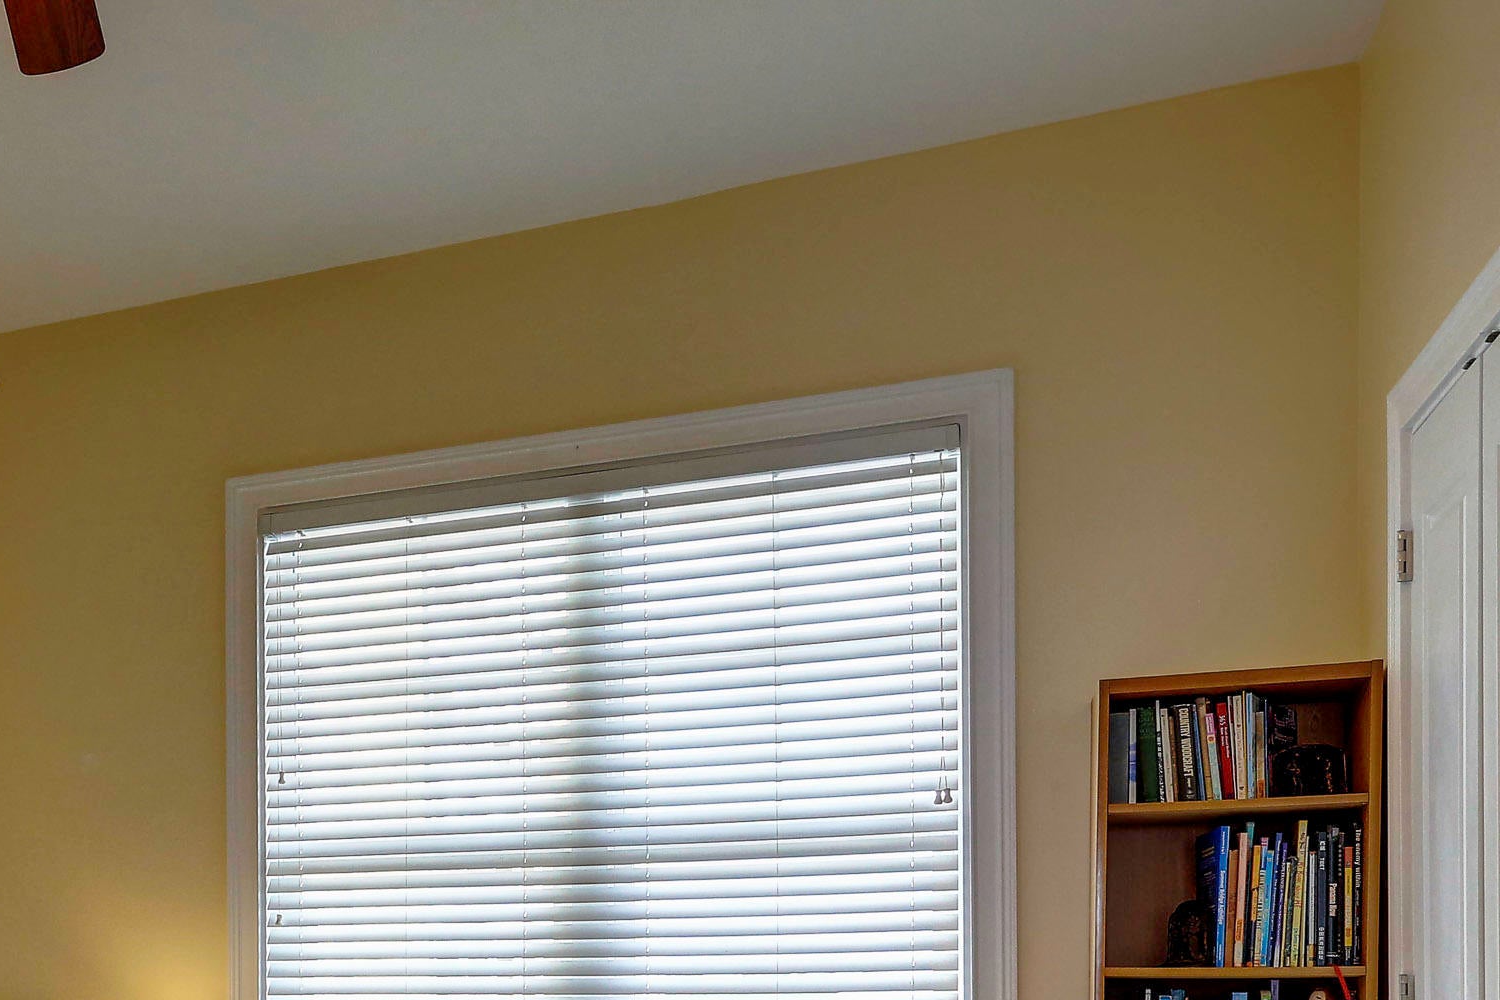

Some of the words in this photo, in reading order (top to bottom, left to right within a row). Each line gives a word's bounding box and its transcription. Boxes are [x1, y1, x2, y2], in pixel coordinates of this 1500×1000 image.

[1179, 708, 1190, 737] COUNTRY
[1181, 738, 1194, 777] WOODCRAFT
[1353, 842, 1361, 866] enemy
[1328, 883, 1338, 904] Panama
